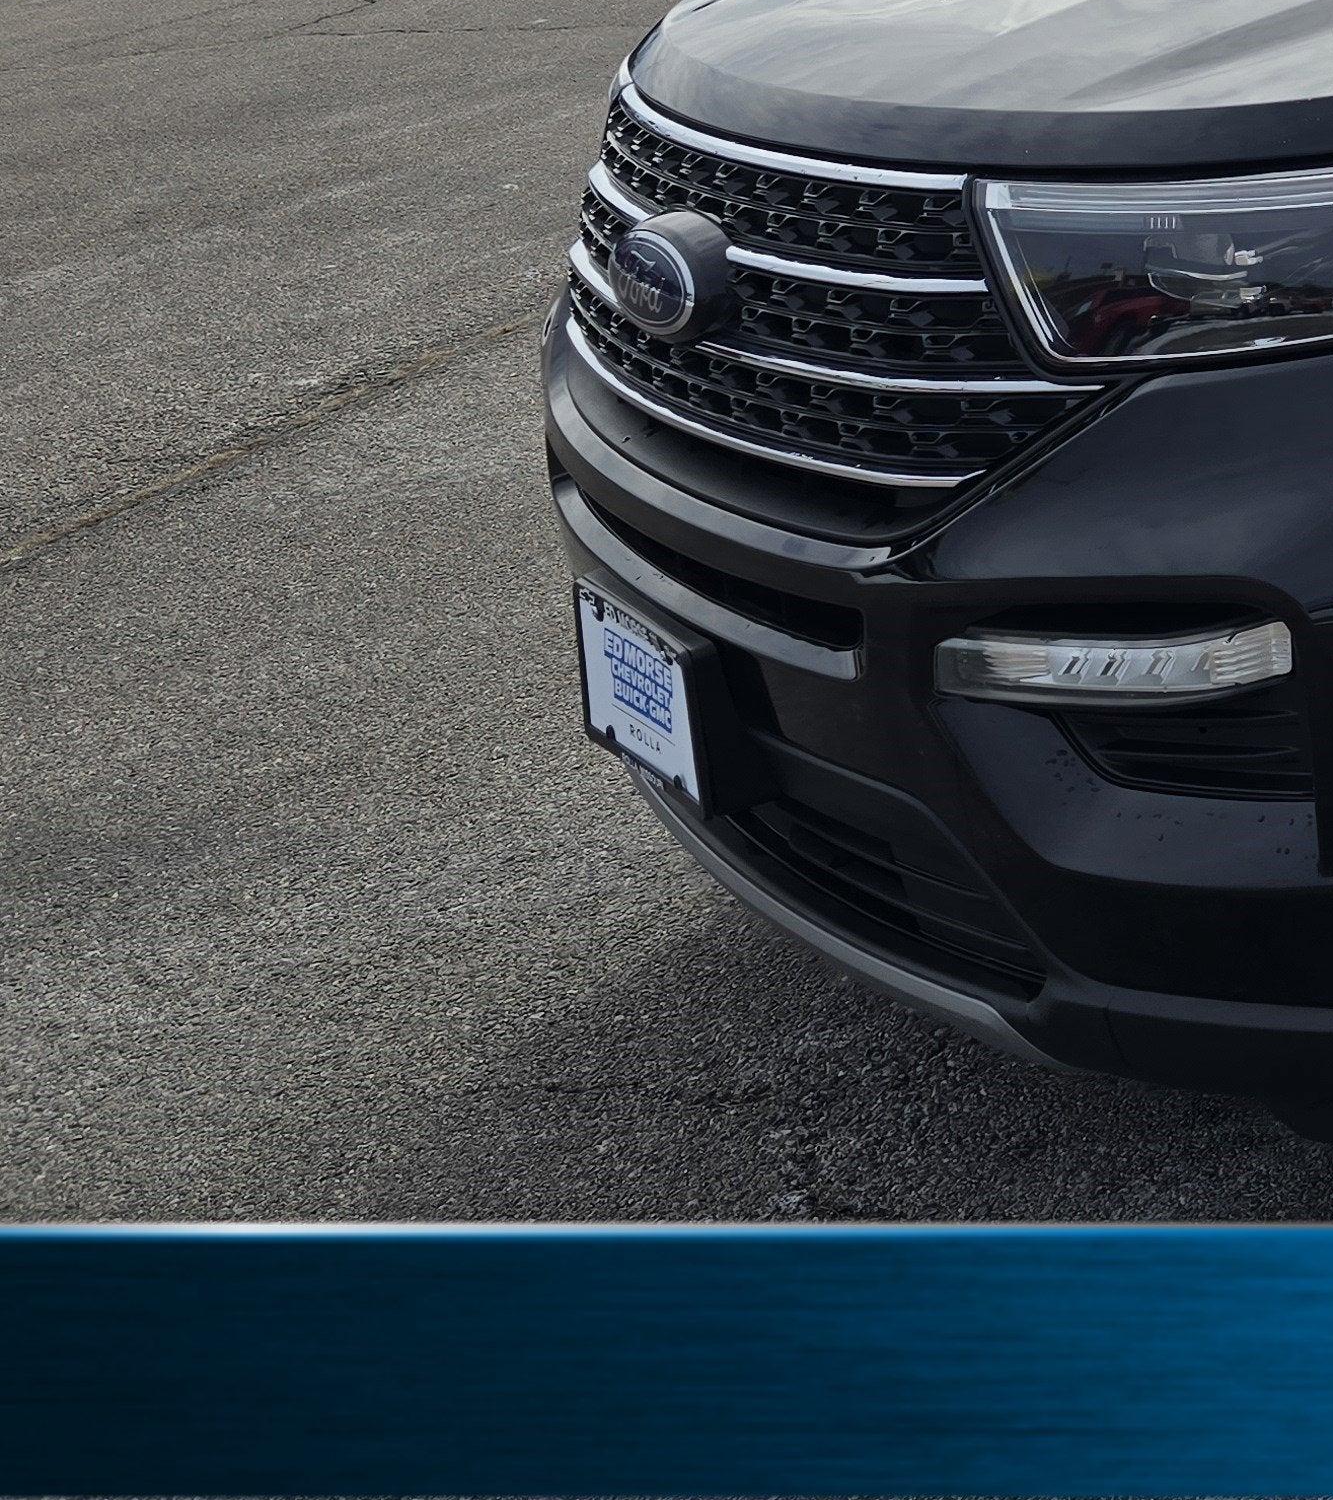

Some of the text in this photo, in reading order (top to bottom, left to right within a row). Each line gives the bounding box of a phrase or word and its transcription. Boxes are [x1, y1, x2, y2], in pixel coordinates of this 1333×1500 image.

[615, 246, 666, 316] Ford
[604, 629, 623, 659] ED
[624, 638, 672, 693] MORSE
[611, 656, 671, 708] CHEVROLET
[629, 723, 662, 754] ROLLA
